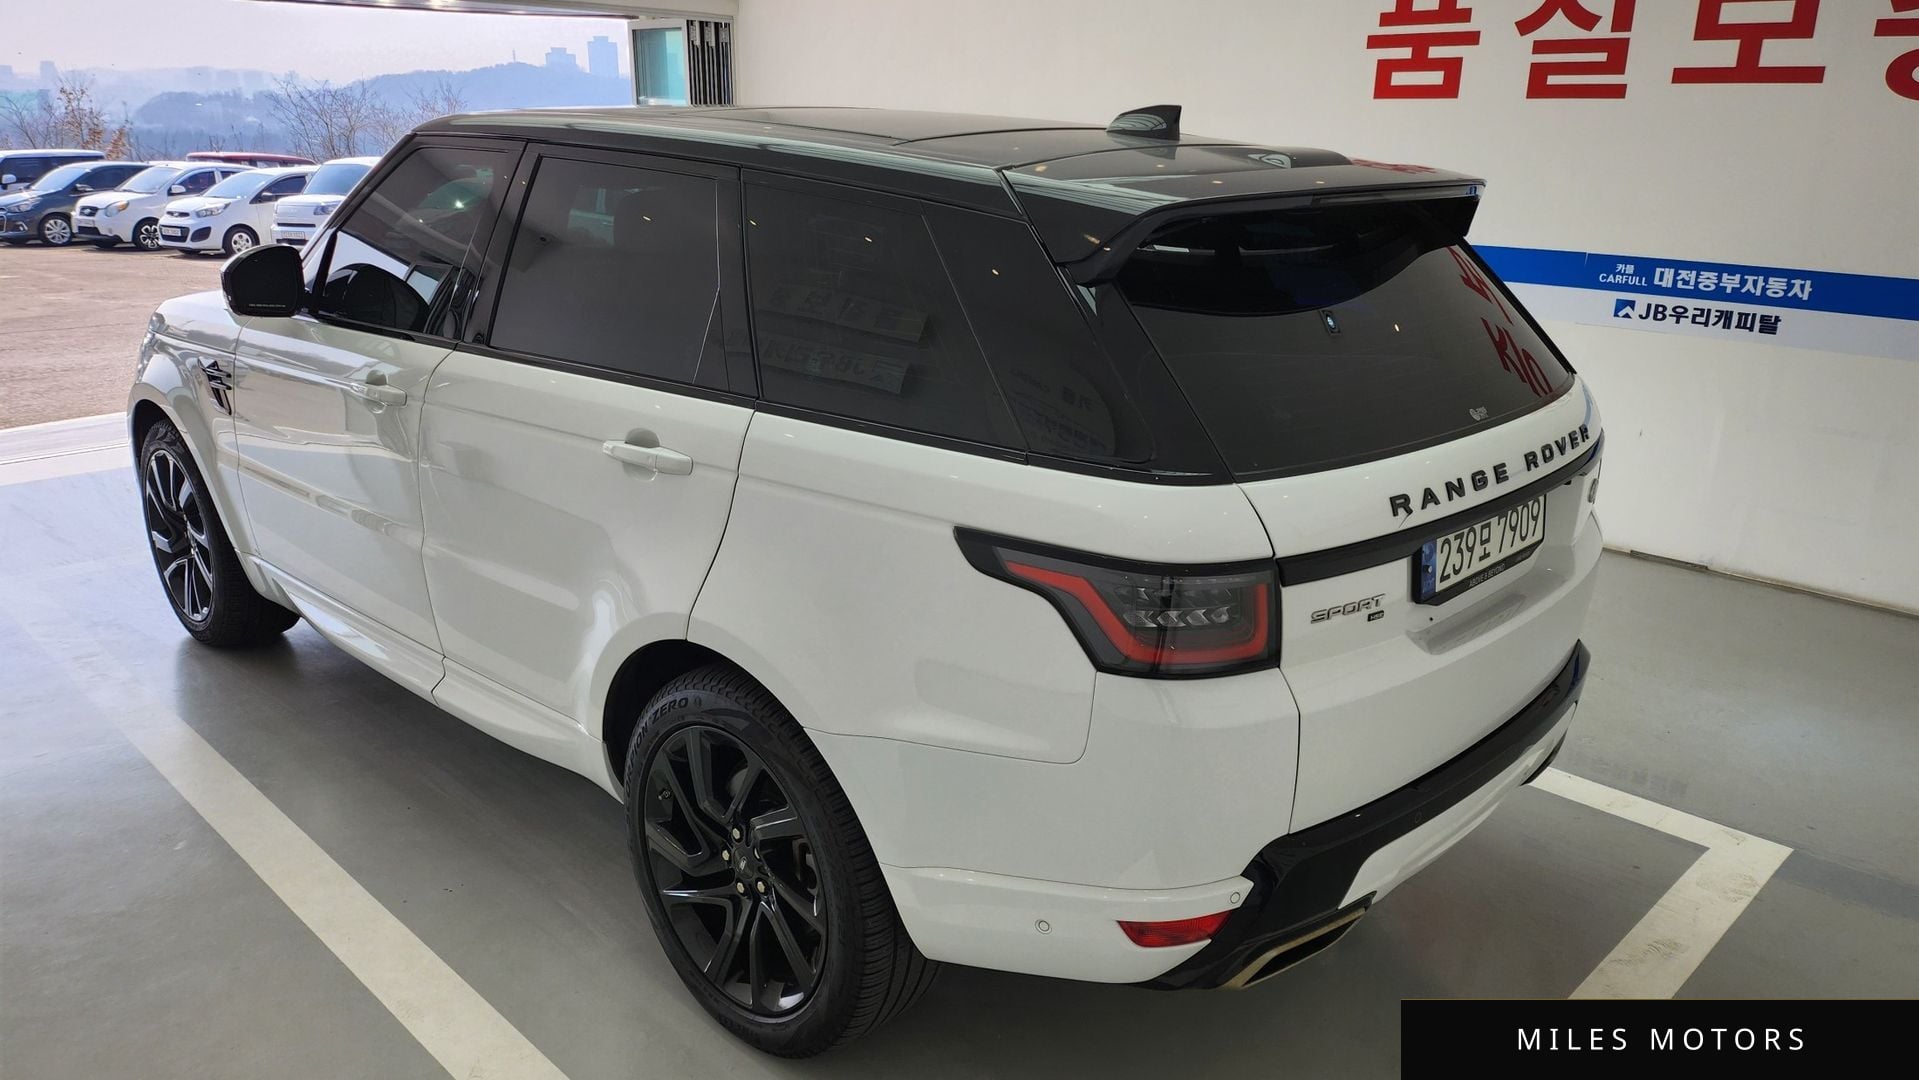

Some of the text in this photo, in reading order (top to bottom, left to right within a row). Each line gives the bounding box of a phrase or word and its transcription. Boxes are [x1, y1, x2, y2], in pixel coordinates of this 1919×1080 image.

[1599, 273, 1648, 287] CARFULL
[1653, 267, 1813, 301] 대전중부자동차
[1638, 303, 1782, 336] JB우리캐피탈
[1389, 423, 1591, 517] RANGE ROVER
[1310, 593, 1386, 624] SPORT
[651, 697, 689, 724] ZERO
